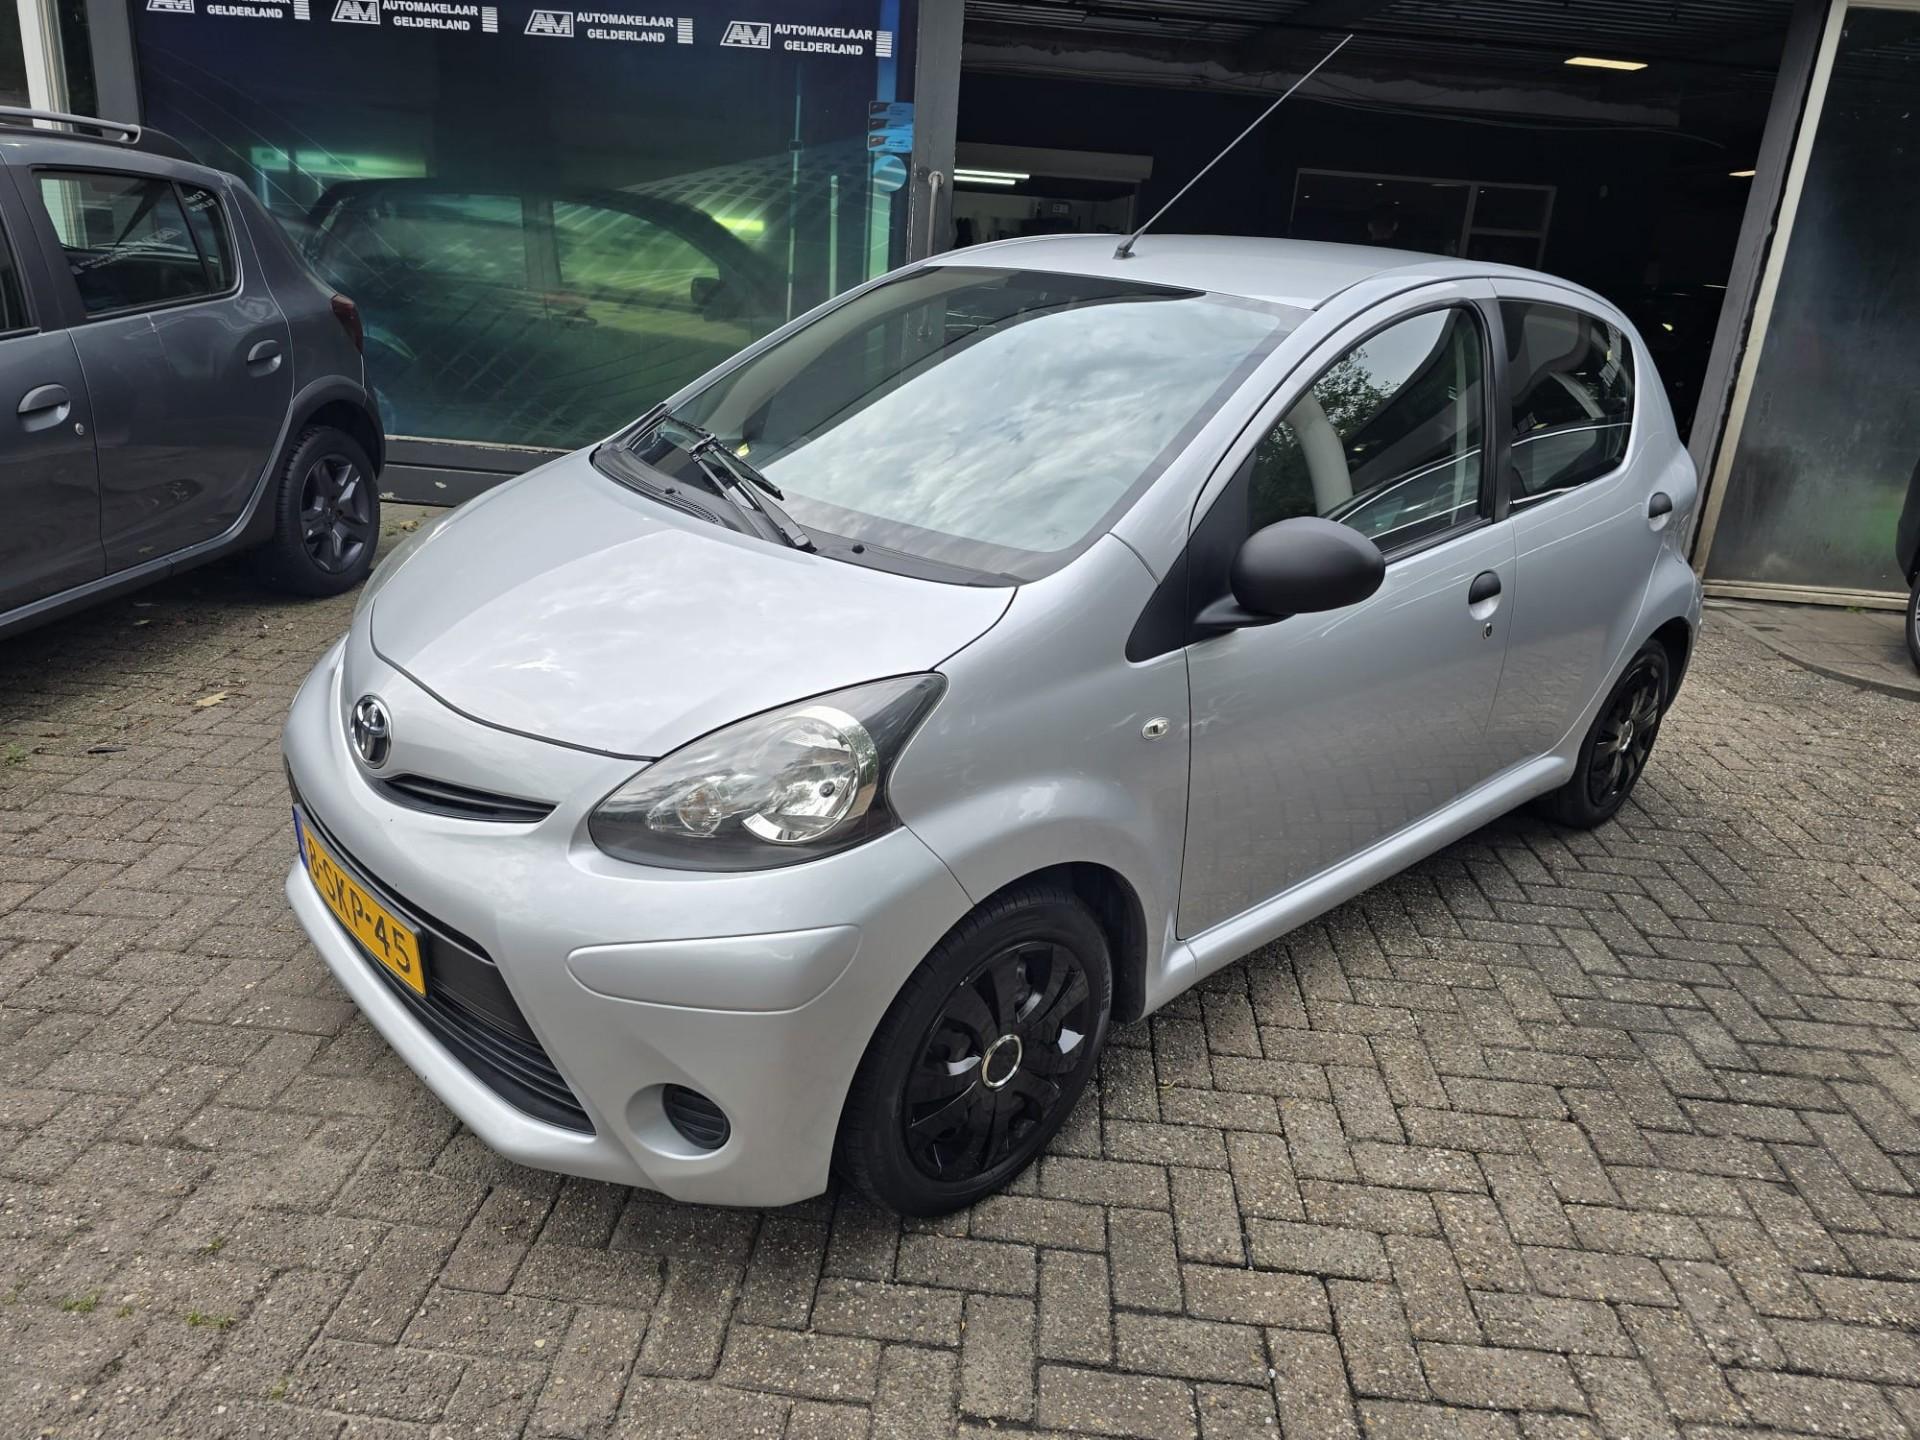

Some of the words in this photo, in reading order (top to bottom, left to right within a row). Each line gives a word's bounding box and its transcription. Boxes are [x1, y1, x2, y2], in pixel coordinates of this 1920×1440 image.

[207, 4, 283, 19] GELDERLAND
[382, 0, 479, 16] AUTOMAKELAAR
[393, 16, 471, 31] GELDERLAND
[528, 13, 572, 35] AM
[576, 12, 674, 28] AUTOMAKELAAR
[587, 28, 666, 43] GELDERLAND
[724, 24, 768, 46] AM
[774, 24, 873, 40] AUTOMAKELAAR
[784, 40, 864, 56] GELDERLAND
